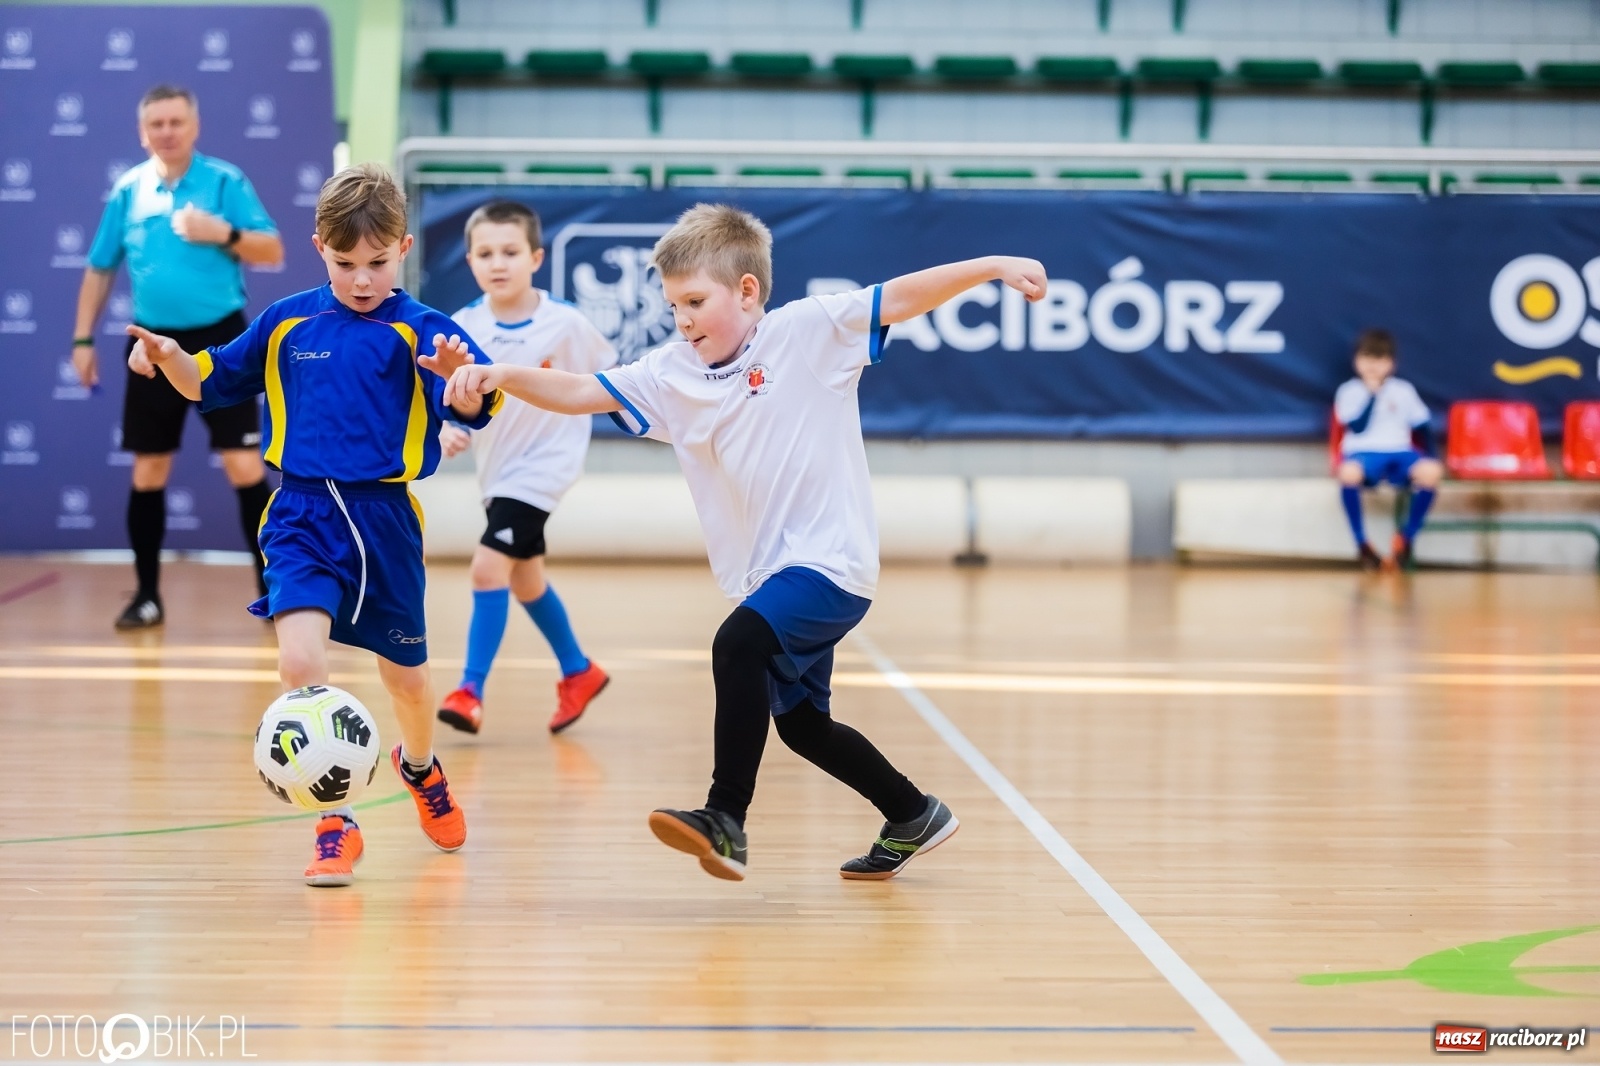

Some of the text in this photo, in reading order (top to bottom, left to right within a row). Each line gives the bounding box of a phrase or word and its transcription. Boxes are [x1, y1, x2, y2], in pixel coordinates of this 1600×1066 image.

[806, 256, 1285, 353] ACIBÓRZ
[296, 351, 331, 360] COLO
[400, 635, 426, 644] COL
